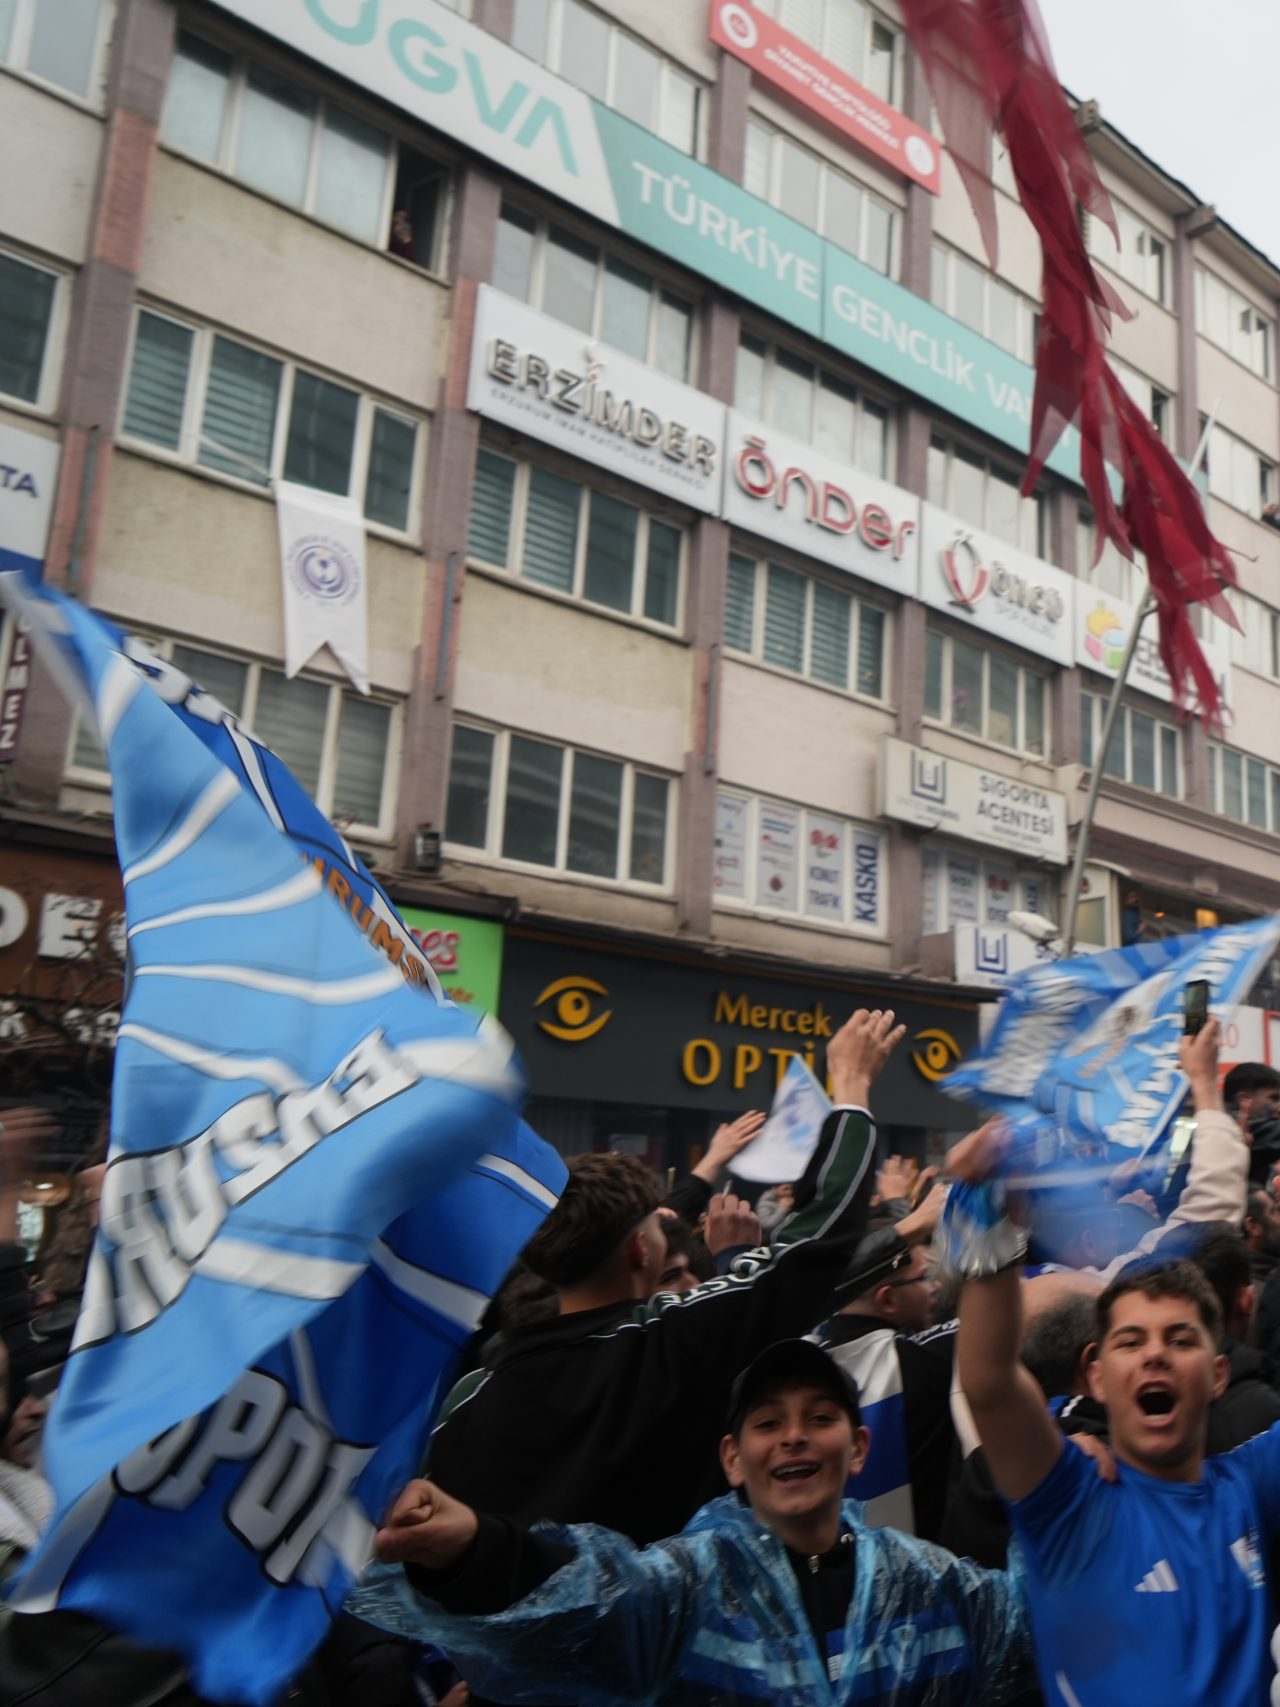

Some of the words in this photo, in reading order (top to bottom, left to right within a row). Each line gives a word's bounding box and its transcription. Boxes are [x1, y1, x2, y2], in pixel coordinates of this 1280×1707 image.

[631, 159, 820, 301] TÜRKİYE
[487, 336, 716, 477] ERZİMDER
[976, 799, 1055, 836] ACENTESİ
[979, 774, 1050, 812] SİGORTA
[854, 844, 879, 922] KASKO
[715, 991, 831, 1038] Mercek
